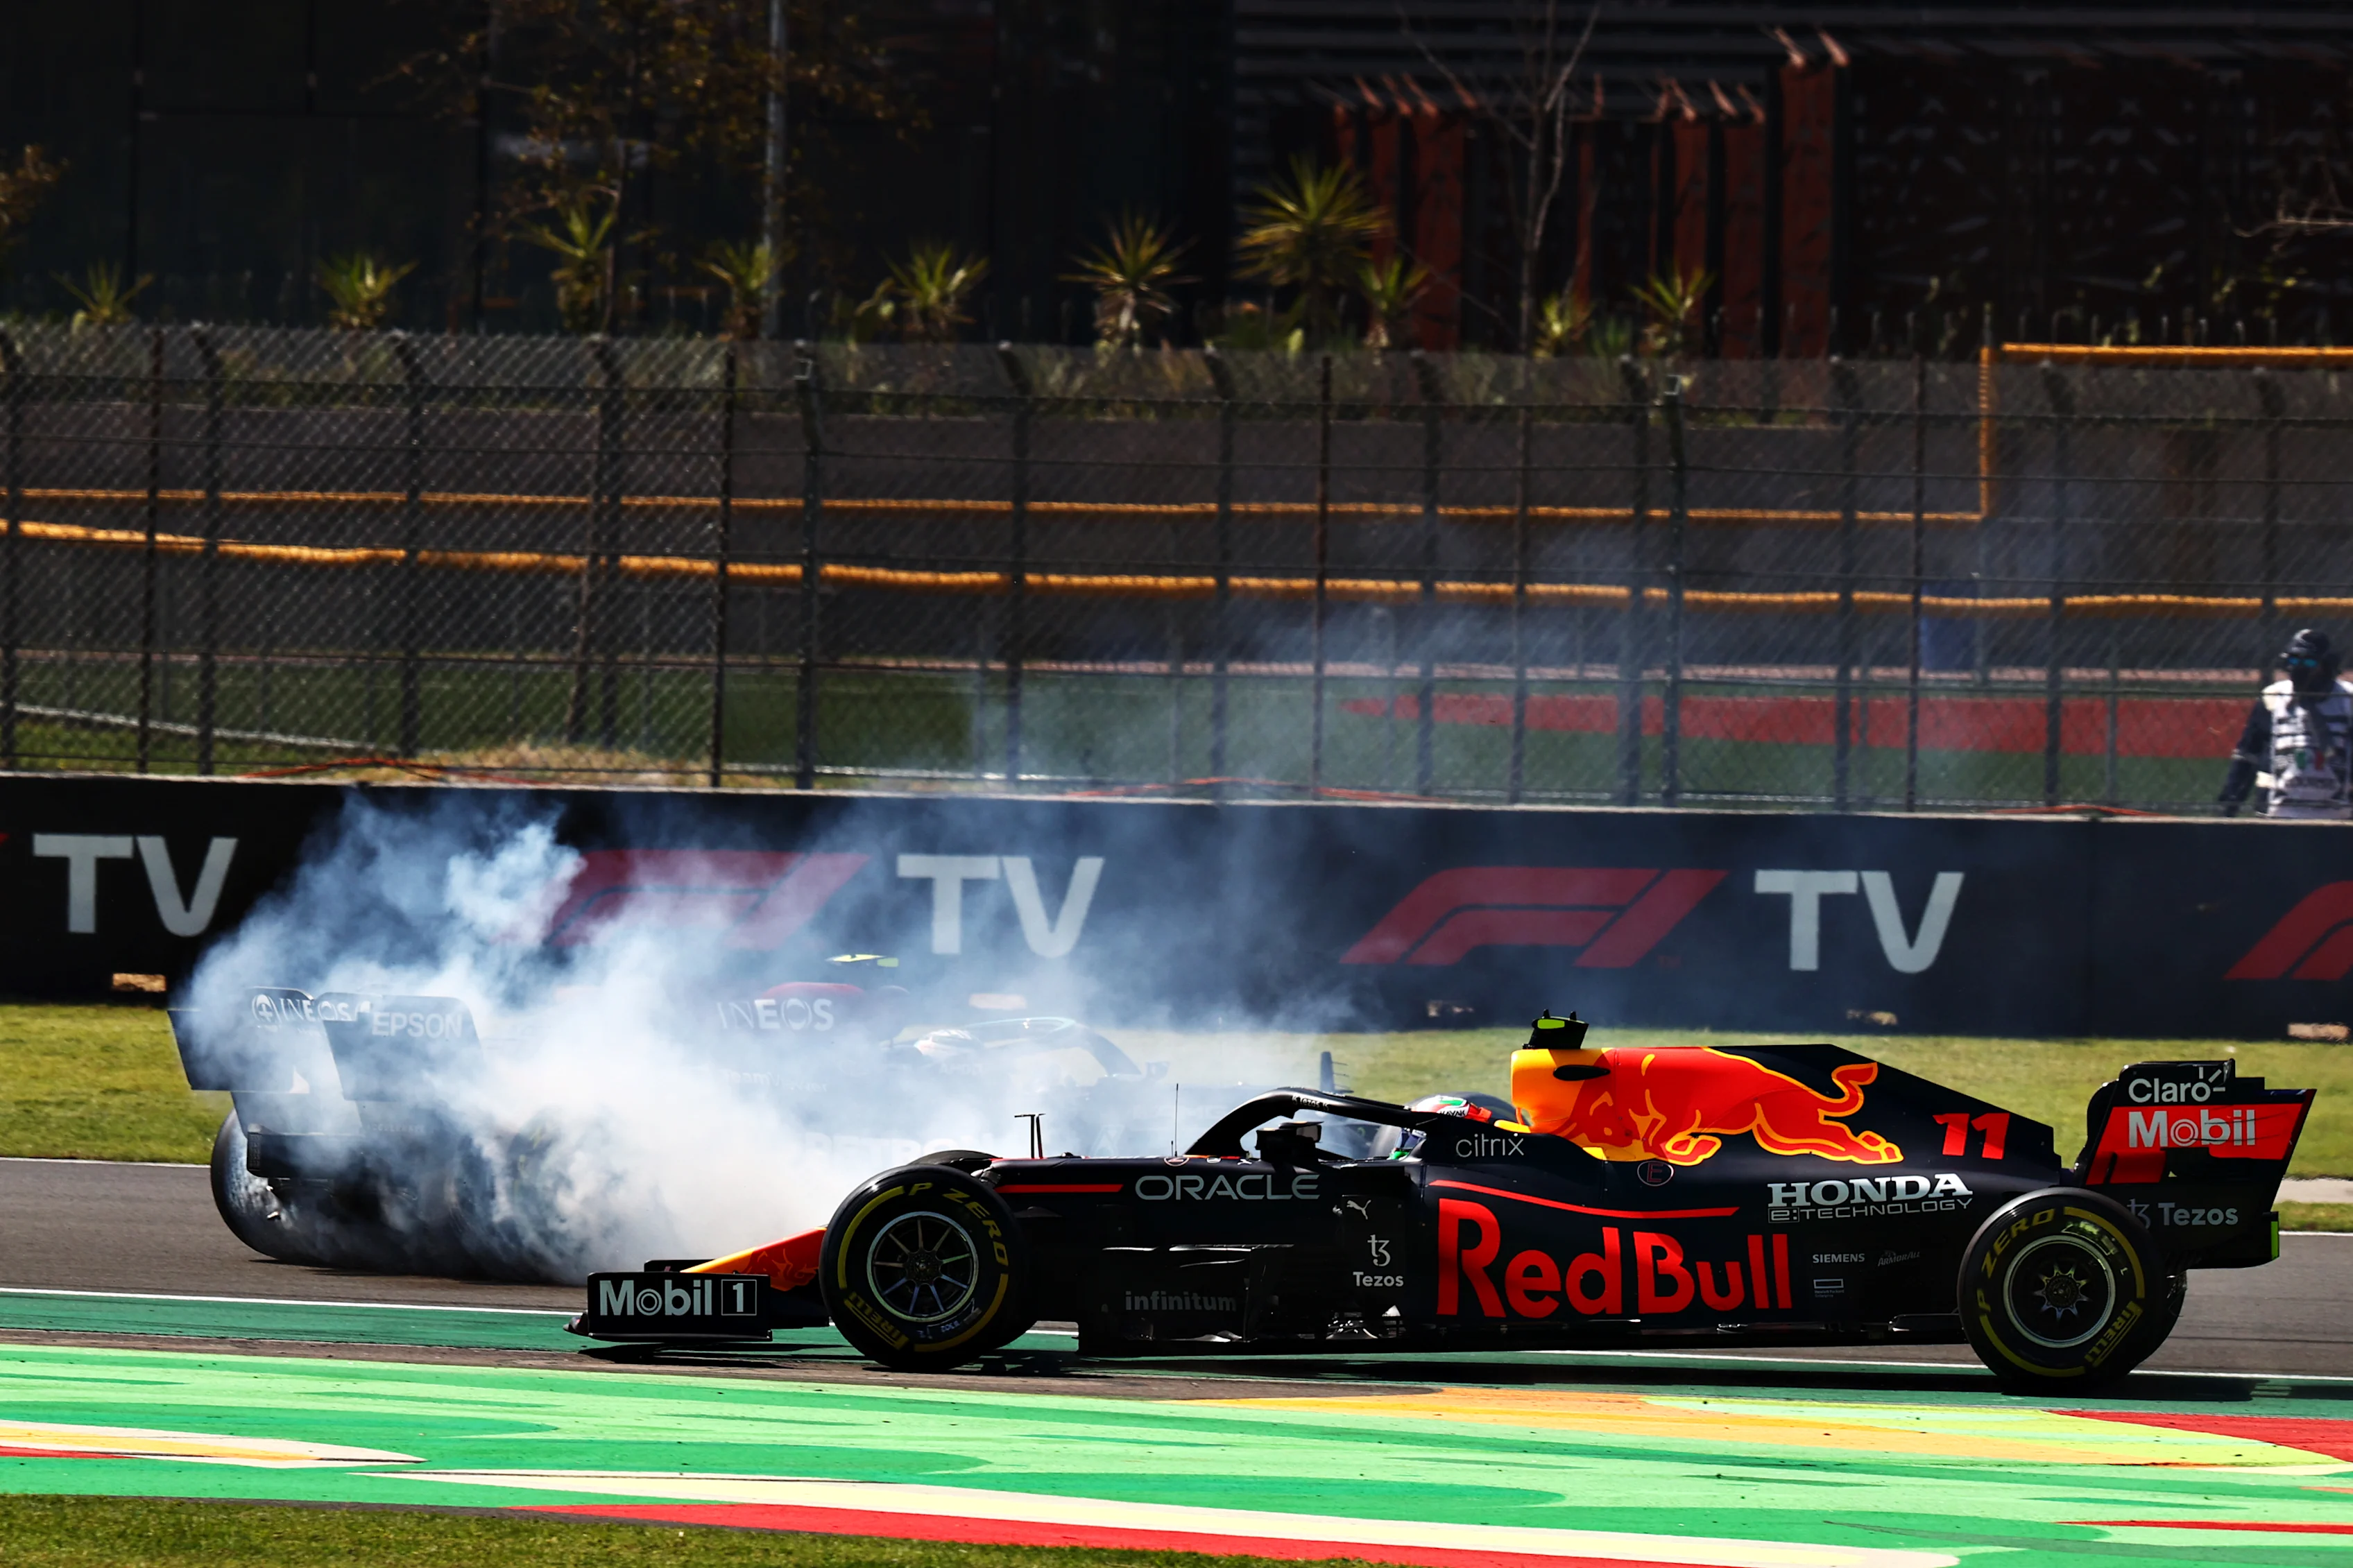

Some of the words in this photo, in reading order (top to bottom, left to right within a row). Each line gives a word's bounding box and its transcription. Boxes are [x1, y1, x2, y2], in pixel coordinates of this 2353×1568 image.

[33, 834, 239, 938] TV
[897, 854, 1105, 958] TV
[1338, 867, 1730, 967] F1
[1754, 870, 1965, 973] TV
[279, 997, 354, 1022] INEOS
[372, 1012, 463, 1039] EPSON
[717, 998, 833, 1032] INEOS
[2128, 1078, 2211, 1103] Claro
[1456, 1133, 1524, 1157] citrix
[1932, 1112, 2010, 1160] 11
[2128, 1110, 2255, 1148] Mobil
[1135, 1175, 1320, 1200] ORACLE
[1768, 1173, 1973, 1207] HONDA
[909, 1182, 934, 1196] P
[942, 1188, 1009, 1266] ZERO
[2158, 1203, 2239, 1225] Tezos
[1813, 1253, 1865, 1264] SIEMENS
[1981, 1208, 2055, 1279] ZERO
[1353, 1272, 1404, 1287] Tezos
[599, 1280, 712, 1316] Mobil
[733, 1283, 744, 1312] 1
[1125, 1291, 1237, 1311] infinitum
[1977, 1289, 1991, 1312] P
[844, 1291, 909, 1350] PIRELLI
[2084, 1300, 2144, 1368] PIRELLI
